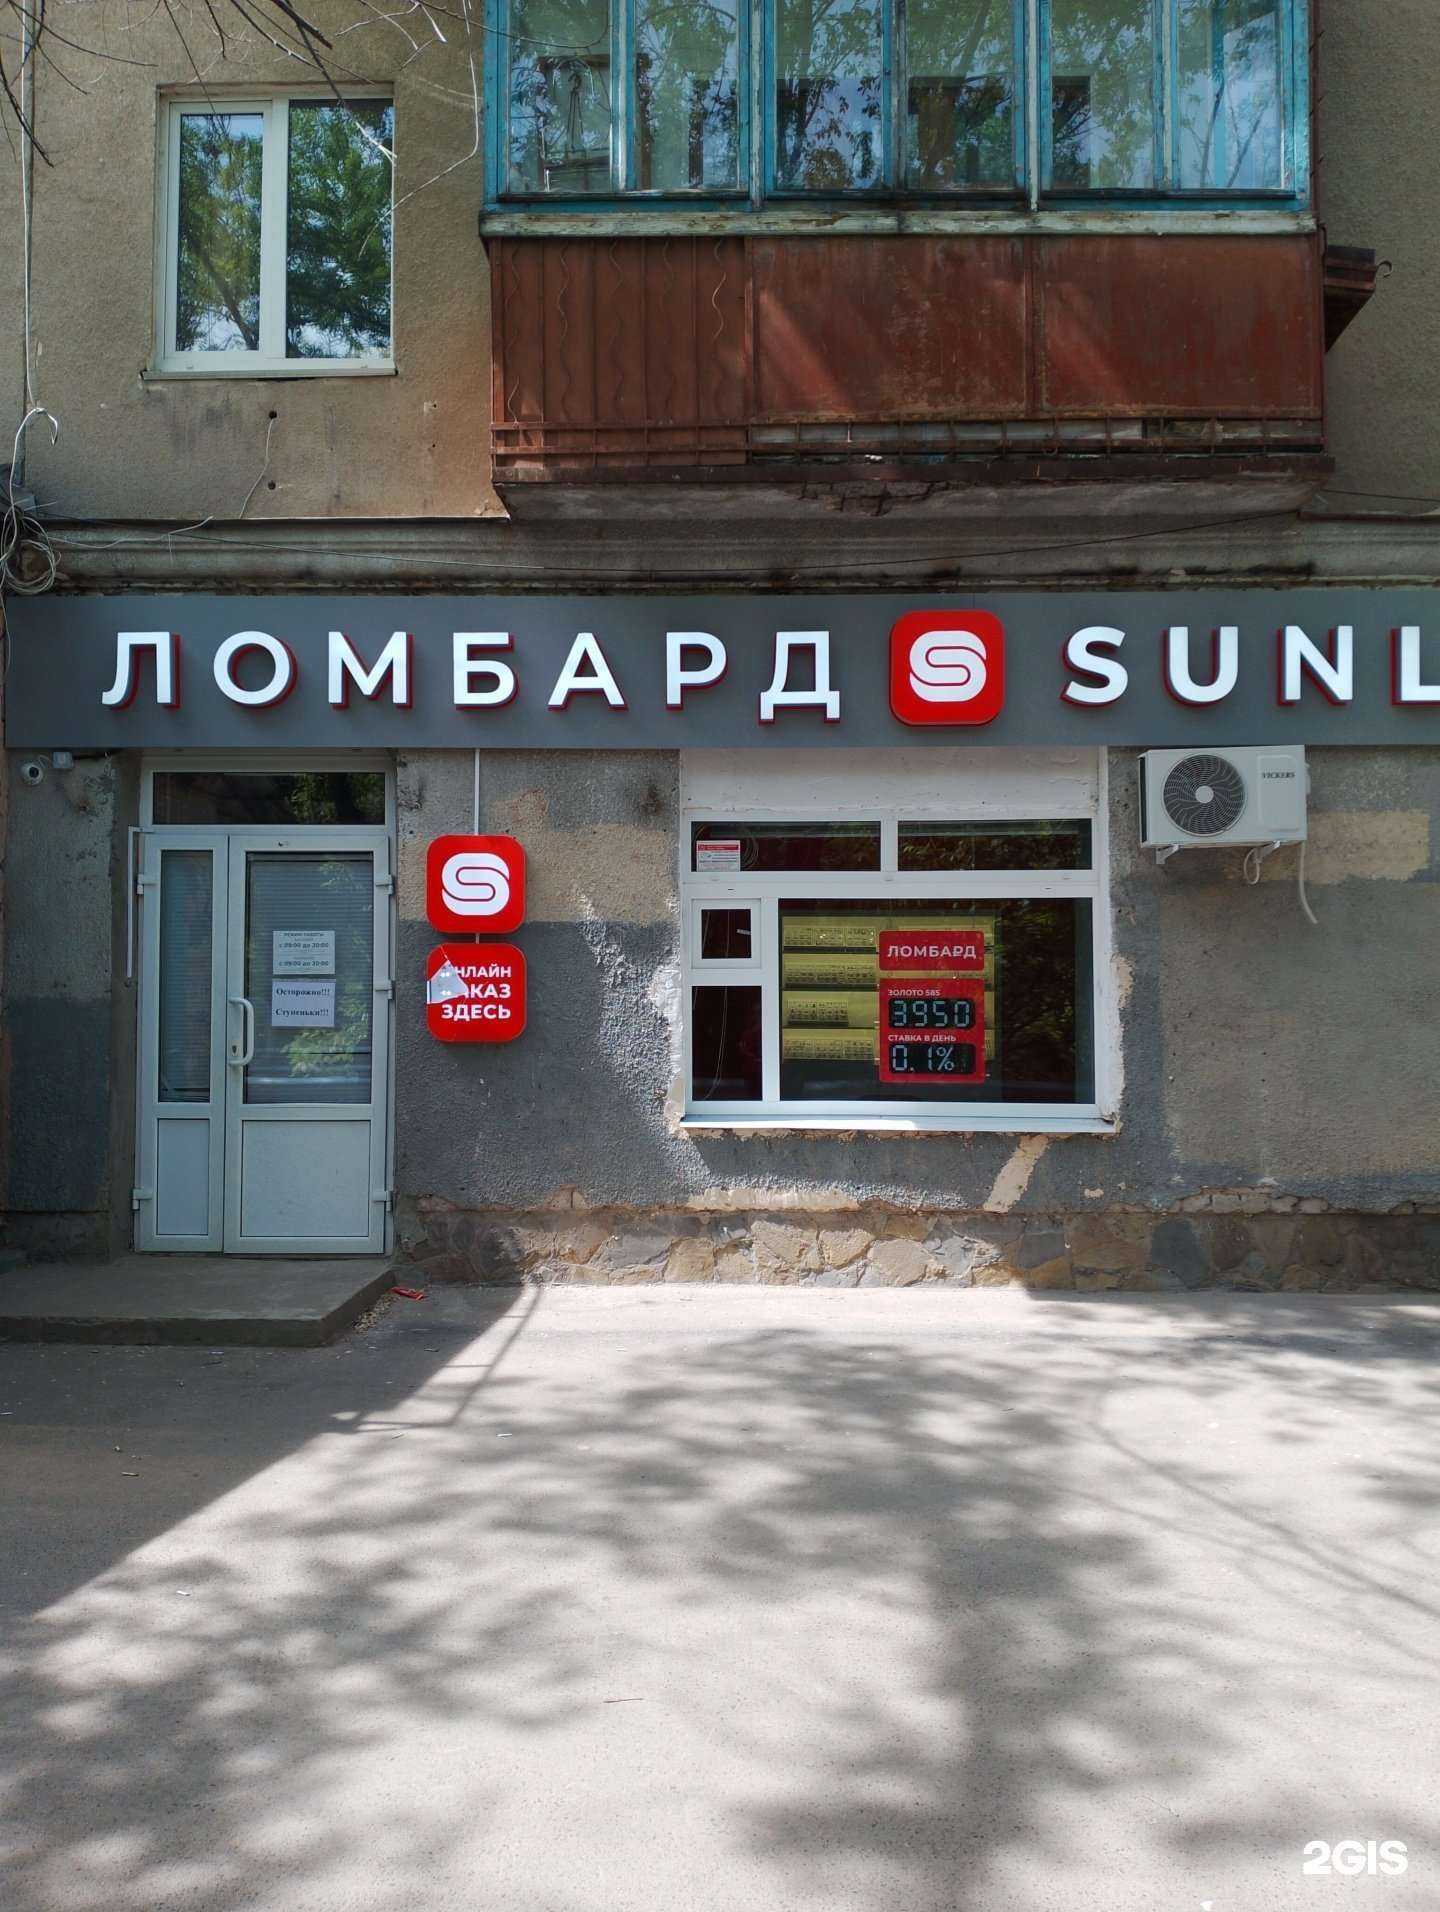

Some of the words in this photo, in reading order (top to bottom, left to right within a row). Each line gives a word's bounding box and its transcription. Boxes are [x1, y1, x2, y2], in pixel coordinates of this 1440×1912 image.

[1062, 624, 1440, 708] SUNL
[101, 629, 841, 724] ЛОМБАРД
[887, 945, 977, 959] ЛОМБАРД
[454, 963, 511, 978] НЛАЙН
[441, 1004, 511, 1021] ЗДЕСЬ
[893, 1000, 970, 1027] 3950
[887, 1034, 922, 1042] СТАВКА
[924, 1034, 930, 1042] В
[931, 1034, 957, 1042] ДЕНЬ
